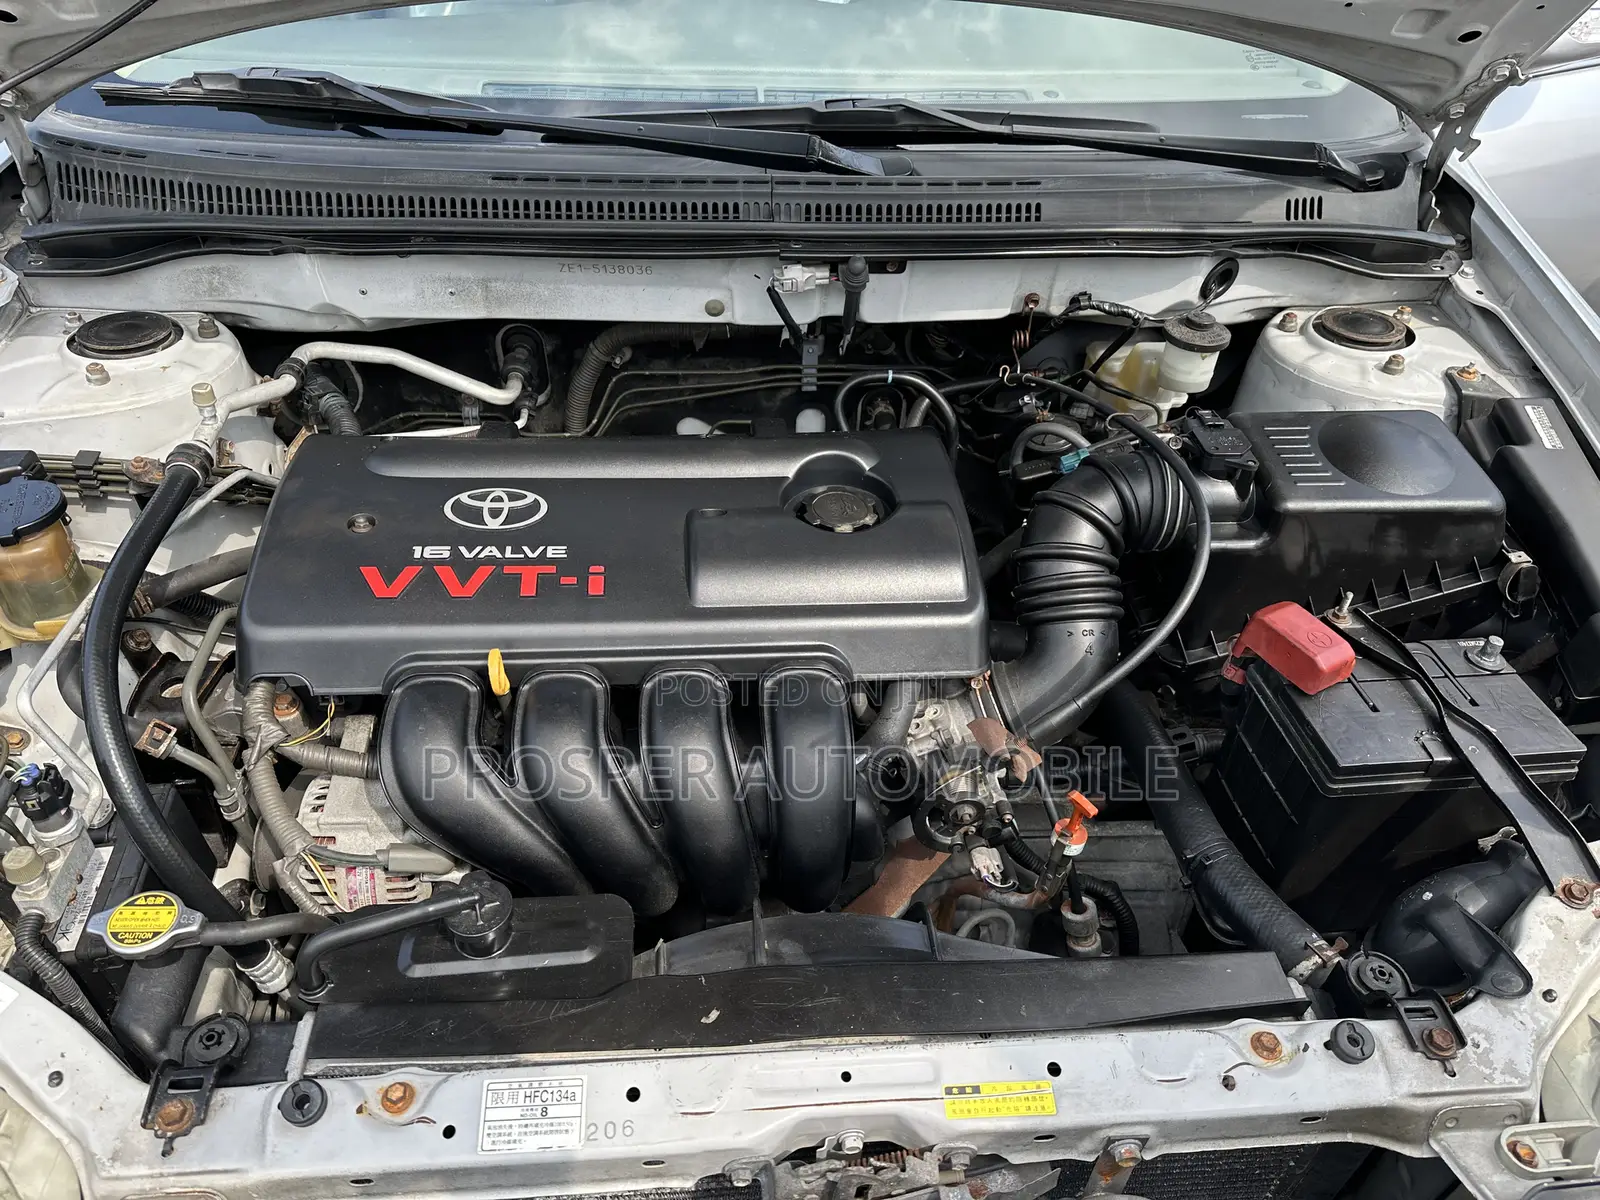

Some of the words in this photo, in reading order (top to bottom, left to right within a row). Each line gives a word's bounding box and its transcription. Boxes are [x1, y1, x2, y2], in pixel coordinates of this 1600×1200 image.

[412, 545, 451, 559] 16
[458, 545, 567, 559] VALVE
[359, 565, 605, 598] VVT-i
[523, 1089, 576, 1104] HFC134a
[540, 1106, 548, 1117] 8
[586, 1120, 634, 1141] 206
